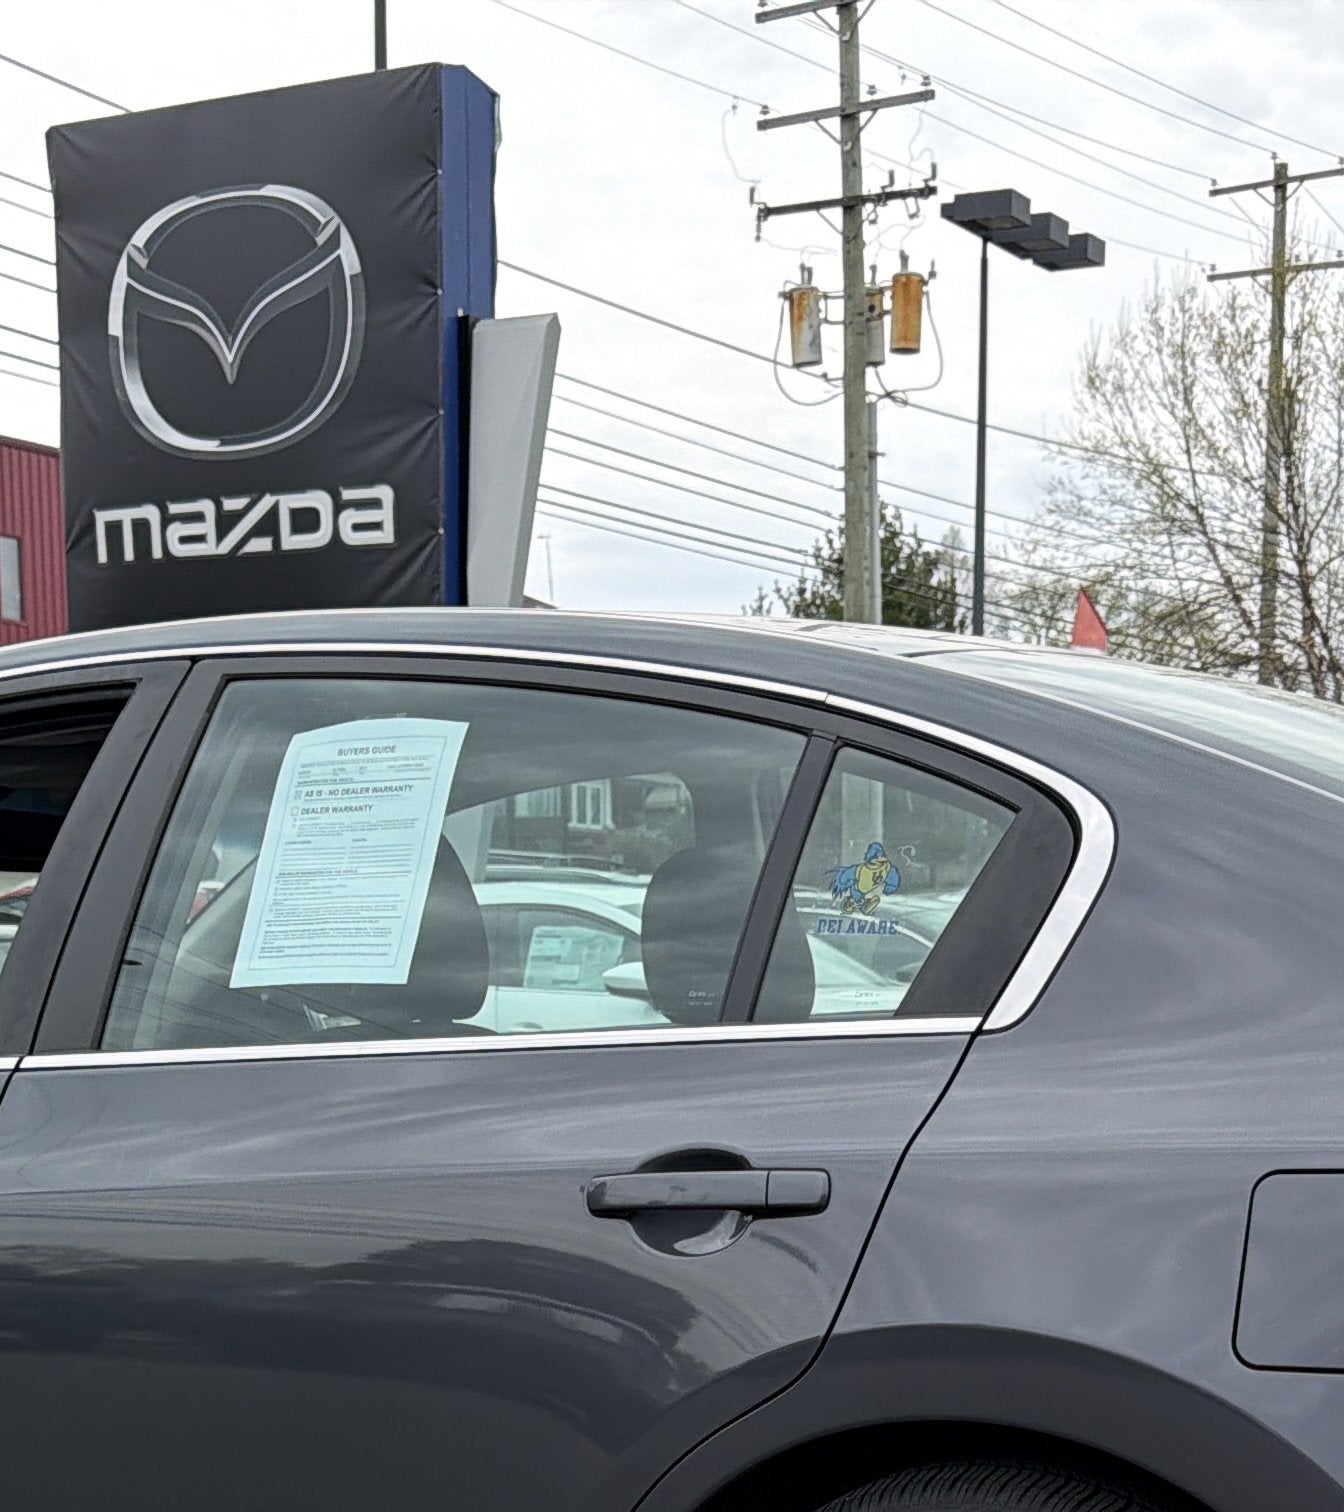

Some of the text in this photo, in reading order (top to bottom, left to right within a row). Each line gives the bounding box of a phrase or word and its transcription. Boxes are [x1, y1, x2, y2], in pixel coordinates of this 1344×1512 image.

[337, 745, 397, 757] BUYERS GUIDE
[304, 790, 314, 798] AS
[315, 789, 323, 797] IS
[328, 788, 340, 797] NO
[341, 786, 371, 796] DEALER
[371, 784, 414, 794] WARRANTY
[301, 804, 374, 815] DEALER WARRANTY
[816, 918, 899, 935] DELAWARE
